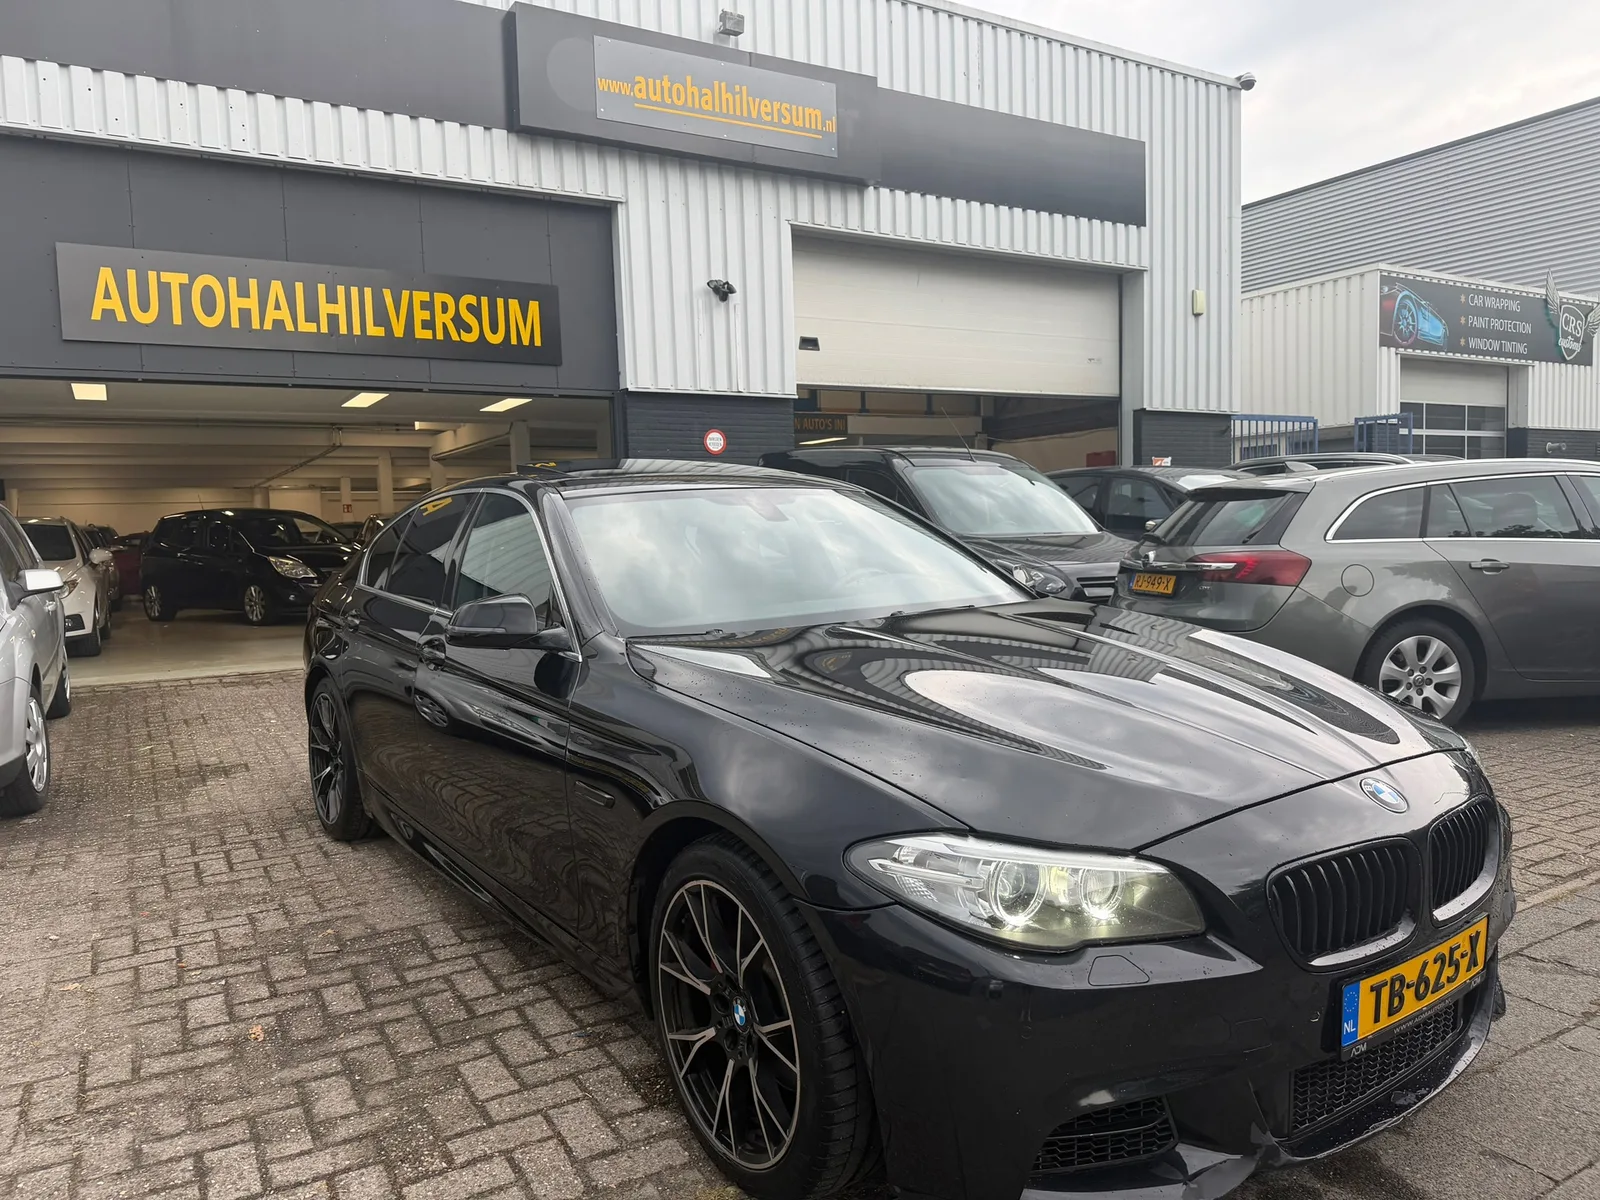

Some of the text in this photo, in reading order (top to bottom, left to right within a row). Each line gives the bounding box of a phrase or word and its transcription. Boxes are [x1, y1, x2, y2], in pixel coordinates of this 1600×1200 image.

[597, 74, 836, 133] www.autohalhilversum.nl
[90, 266, 542, 347] AUTOHALHILVERSUM
[1468, 294, 1521, 312] CAR WRAPPING
[1468, 315, 1532, 334] PAINT PROTECTION
[1562, 313, 1583, 337] CRS
[1468, 337, 1528, 355] WINDOW TINTING
[1134, 575, 1172, 591] RJ-949-X
[1370, 929, 1481, 1024] TB-625-X
[1343, 1019, 1356, 1035] NL
